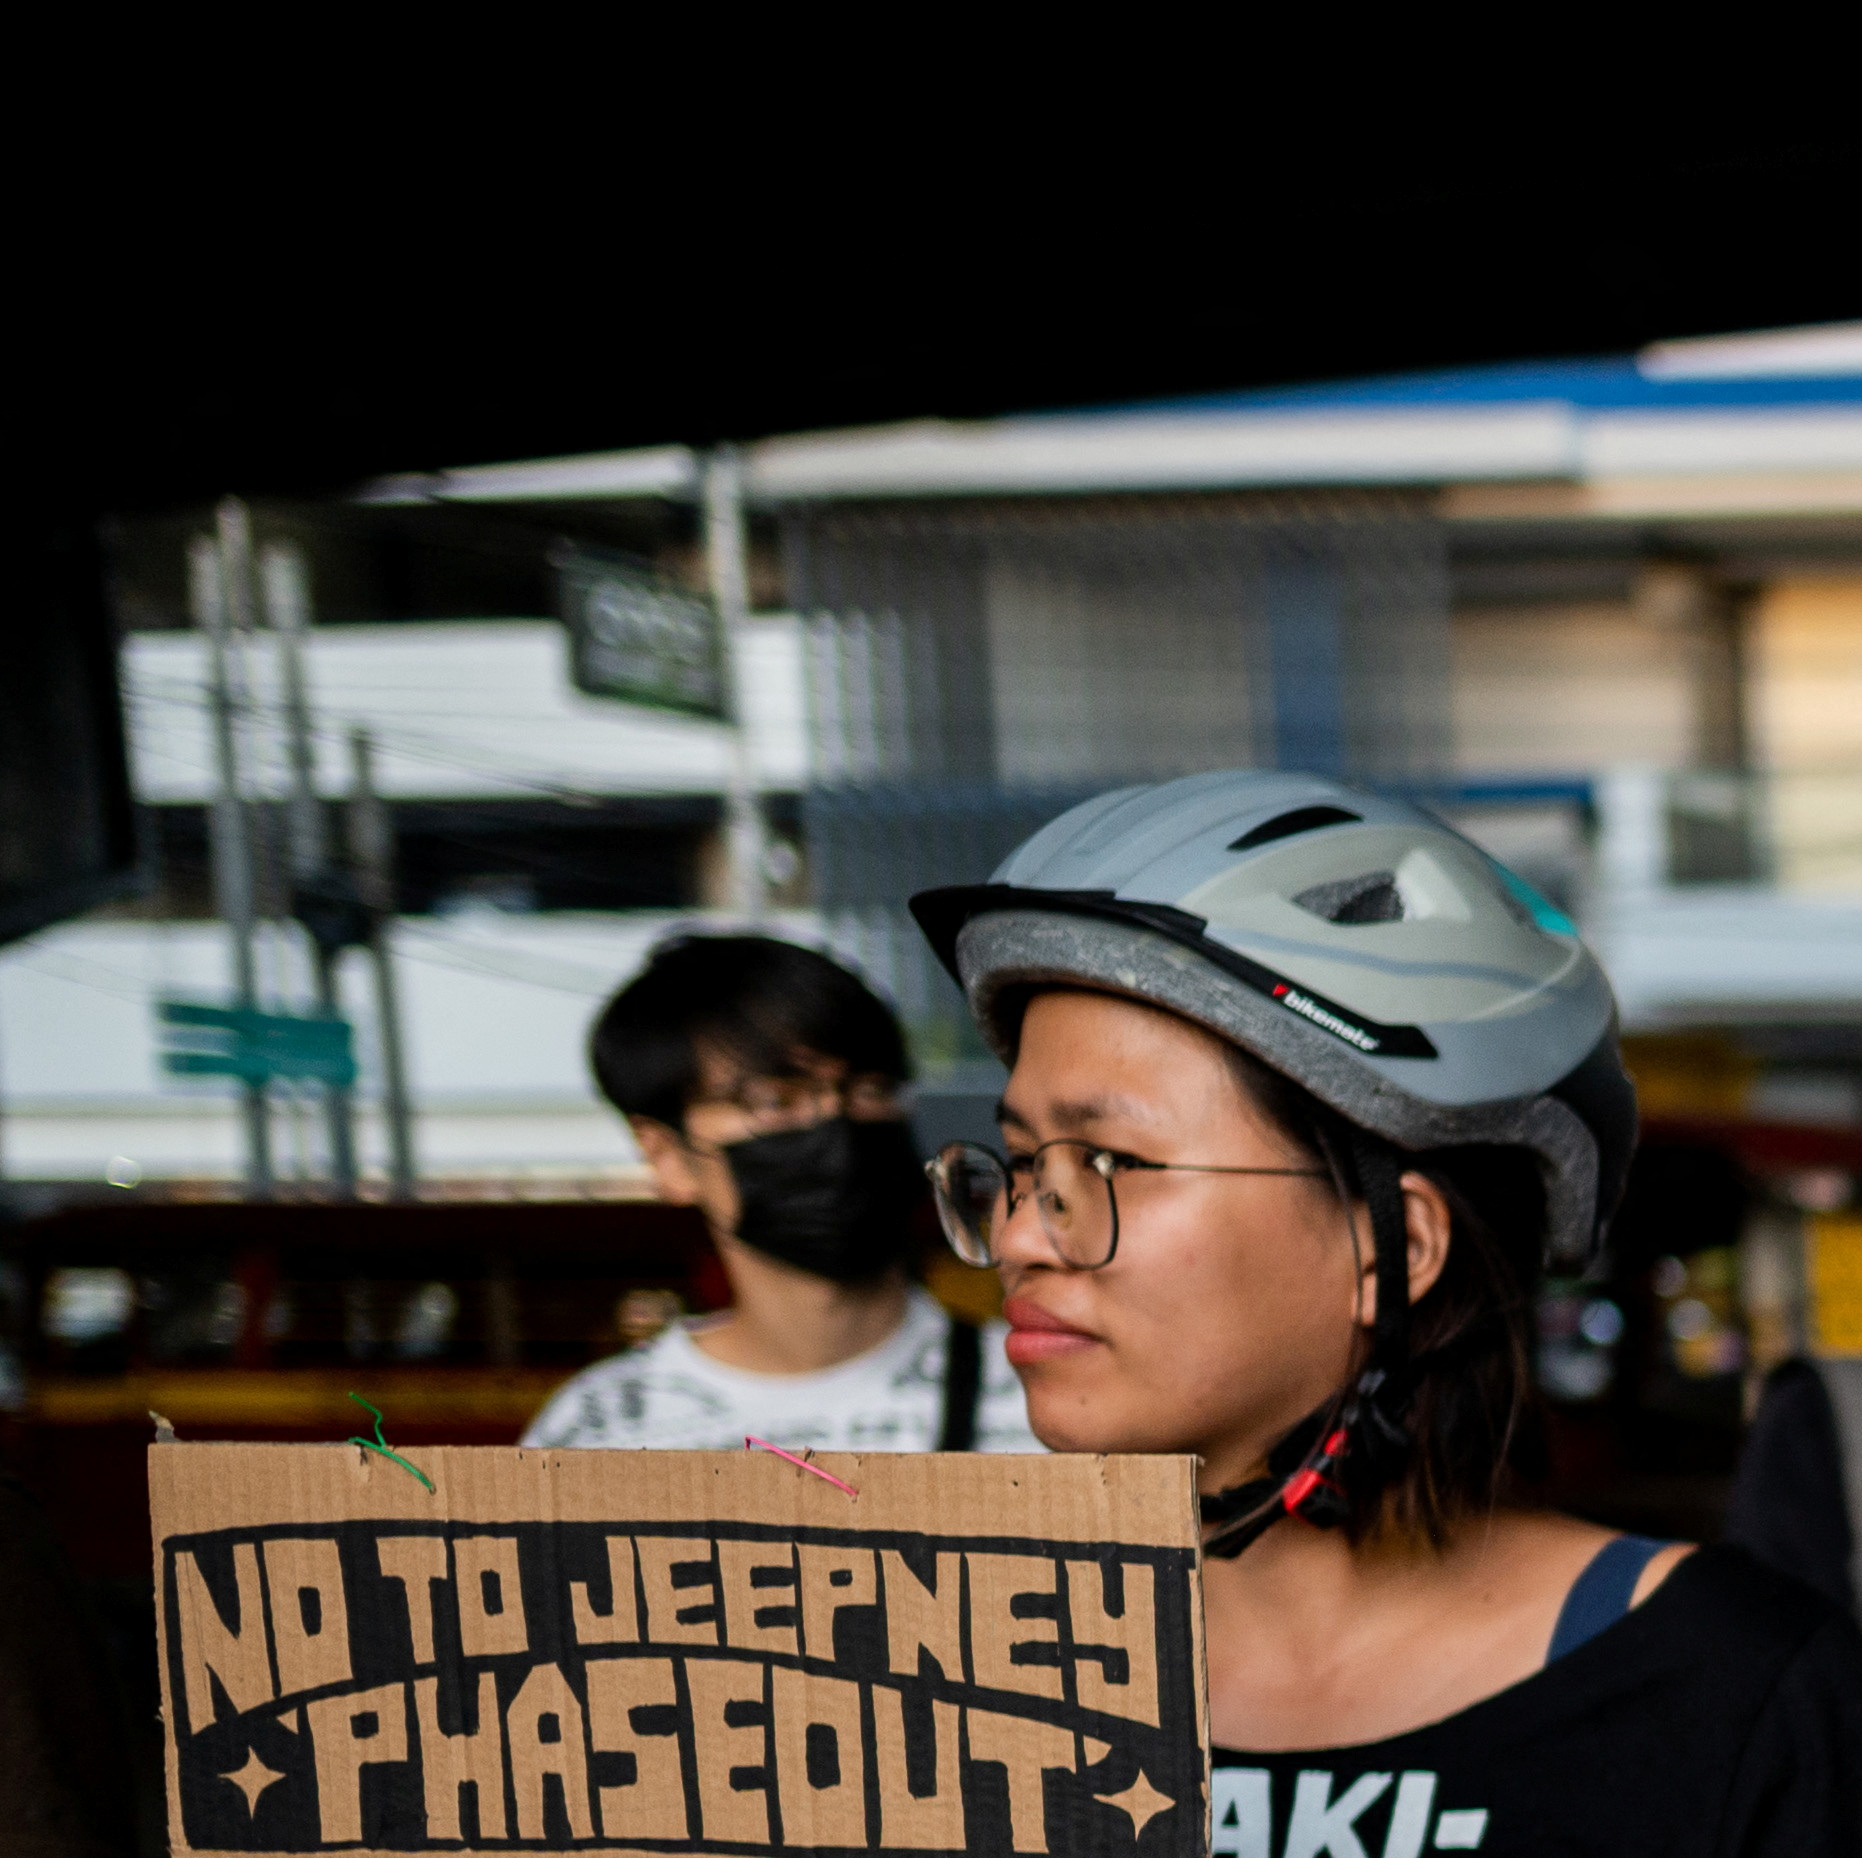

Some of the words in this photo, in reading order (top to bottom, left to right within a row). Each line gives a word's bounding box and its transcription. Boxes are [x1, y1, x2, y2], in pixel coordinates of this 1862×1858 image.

[174, 1536, 352, 1736] NO
[375, 1535, 529, 1666] TO
[568, 1535, 1161, 1729] JEEPNEY
[303, 1655, 1077, 1854] PHASEOUT
